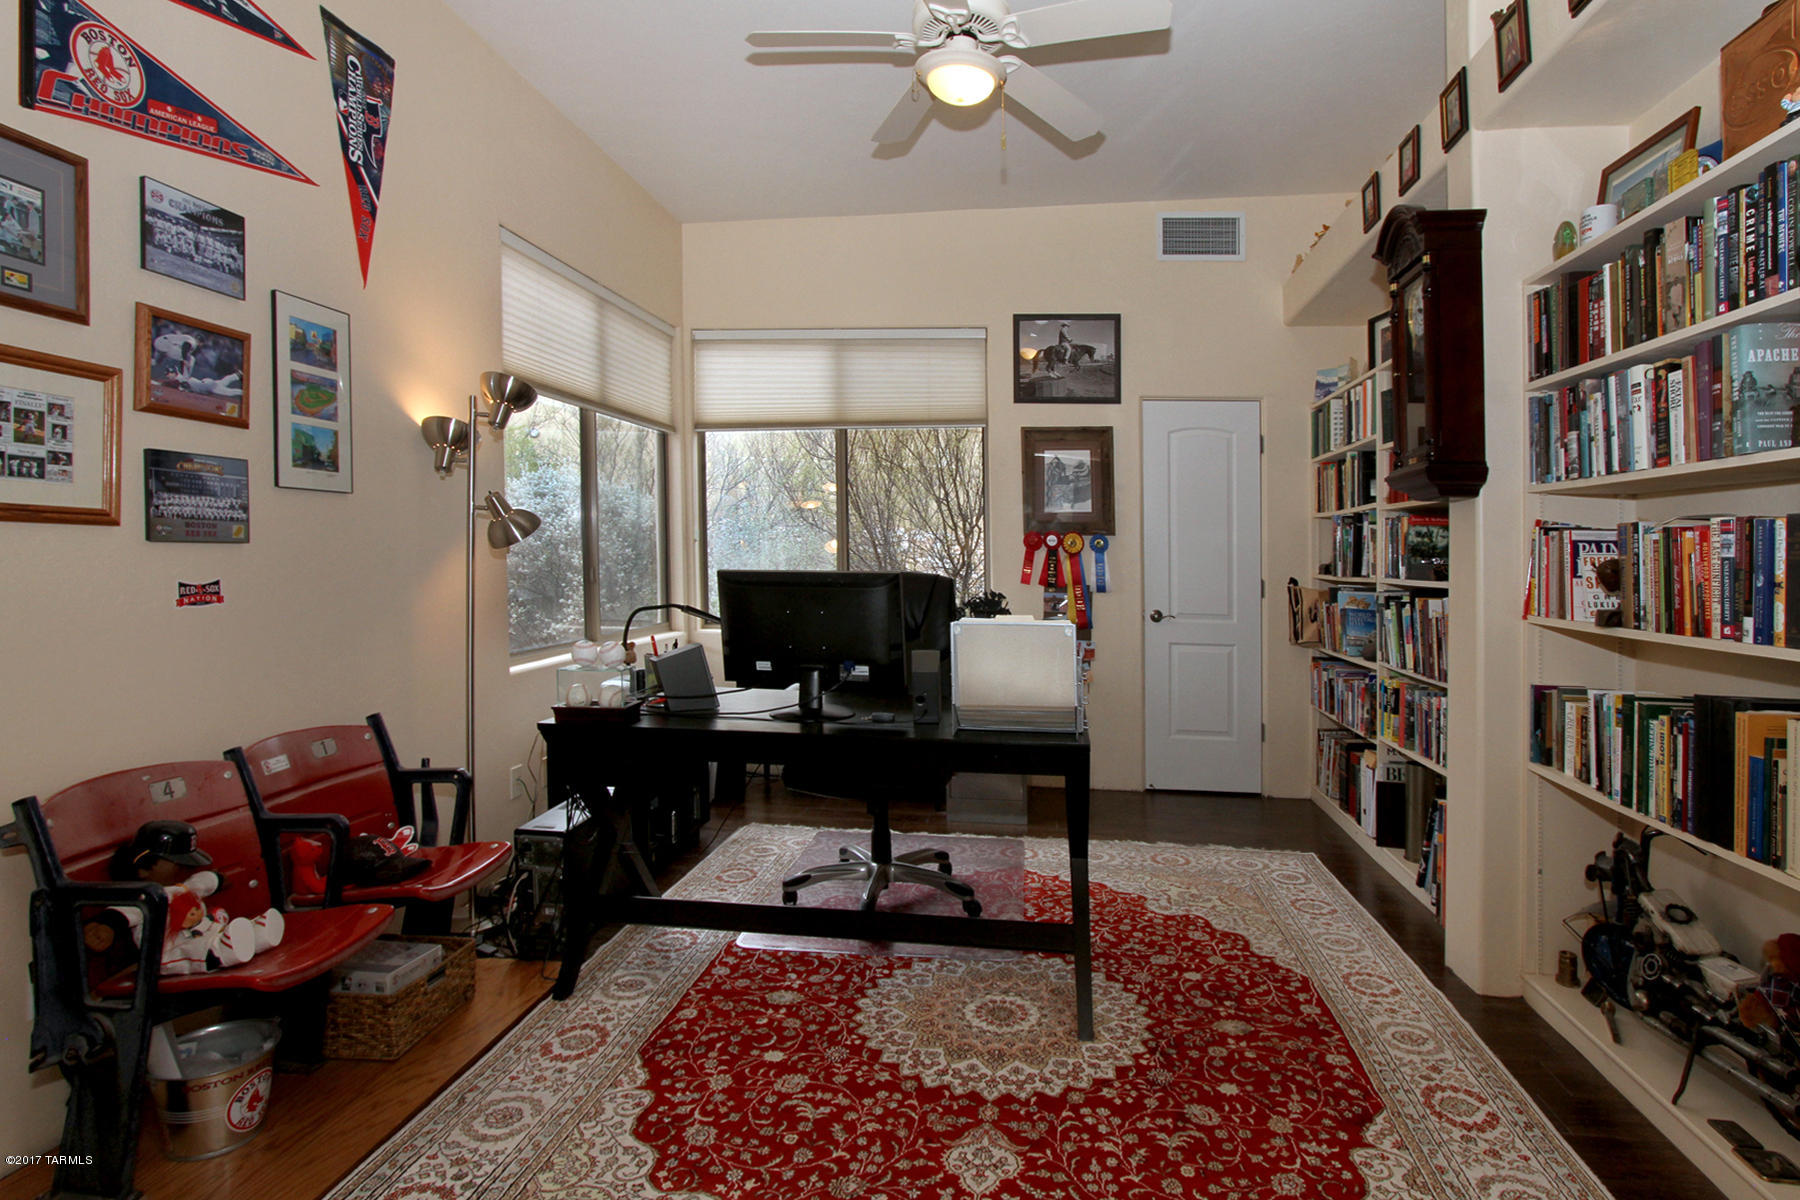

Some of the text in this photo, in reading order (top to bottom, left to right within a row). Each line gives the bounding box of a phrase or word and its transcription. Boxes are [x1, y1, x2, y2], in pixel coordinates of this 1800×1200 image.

[81, 28, 137, 68] BOSTON
[85, 67, 136, 103] RED SOX
[149, 107, 188, 125] AMERICAN
[188, 118, 216, 133] LEAGUE
[347, 54, 364, 166] CHAMPIONS
[1746, 208, 1756, 253] CRIME
[1747, 347, 1799, 362] APACHE
[1711, 521, 1721, 604] THE LAST GUNFIGHT
[180, 584, 219, 595] RED SOX
[184, 595, 218, 604] NATION
[163, 781, 175, 799] 4
